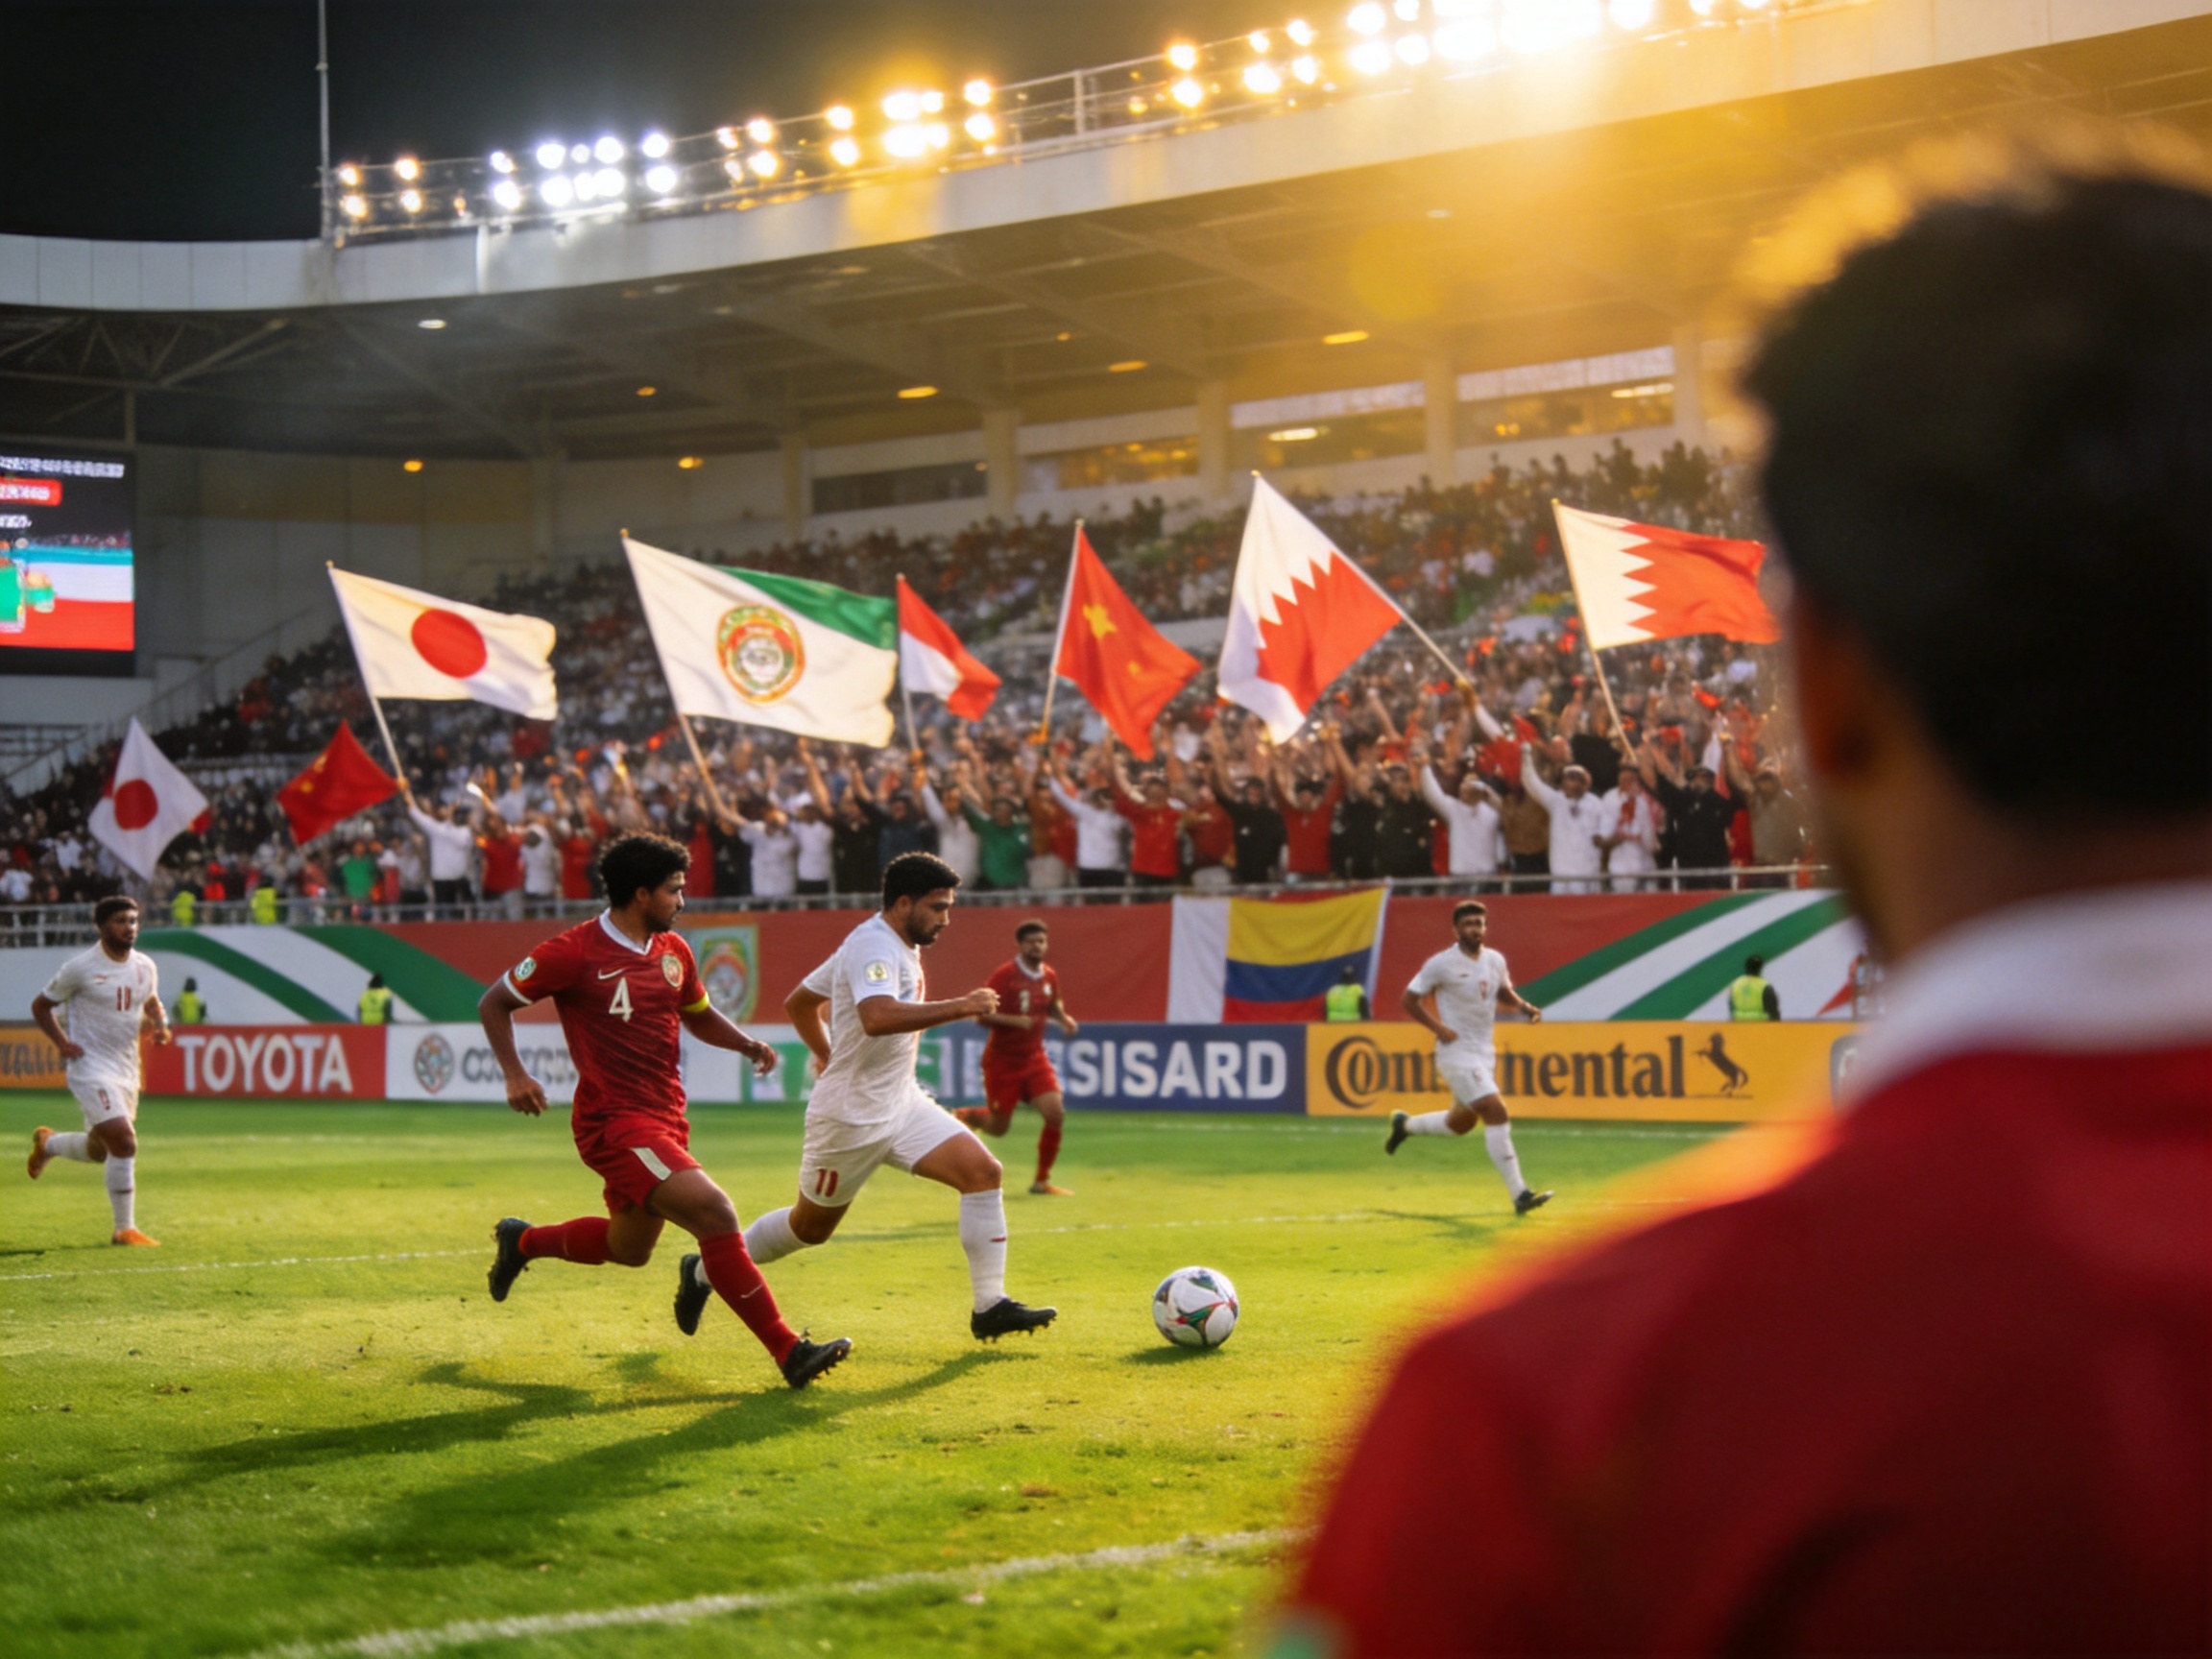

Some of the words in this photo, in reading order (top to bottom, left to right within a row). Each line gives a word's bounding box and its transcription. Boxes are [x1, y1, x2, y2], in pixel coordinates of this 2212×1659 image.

[609, 976, 634, 1023] 4
[176, 1034, 353, 1094] TOYOTA
[815, 1167, 839, 1197] 11
